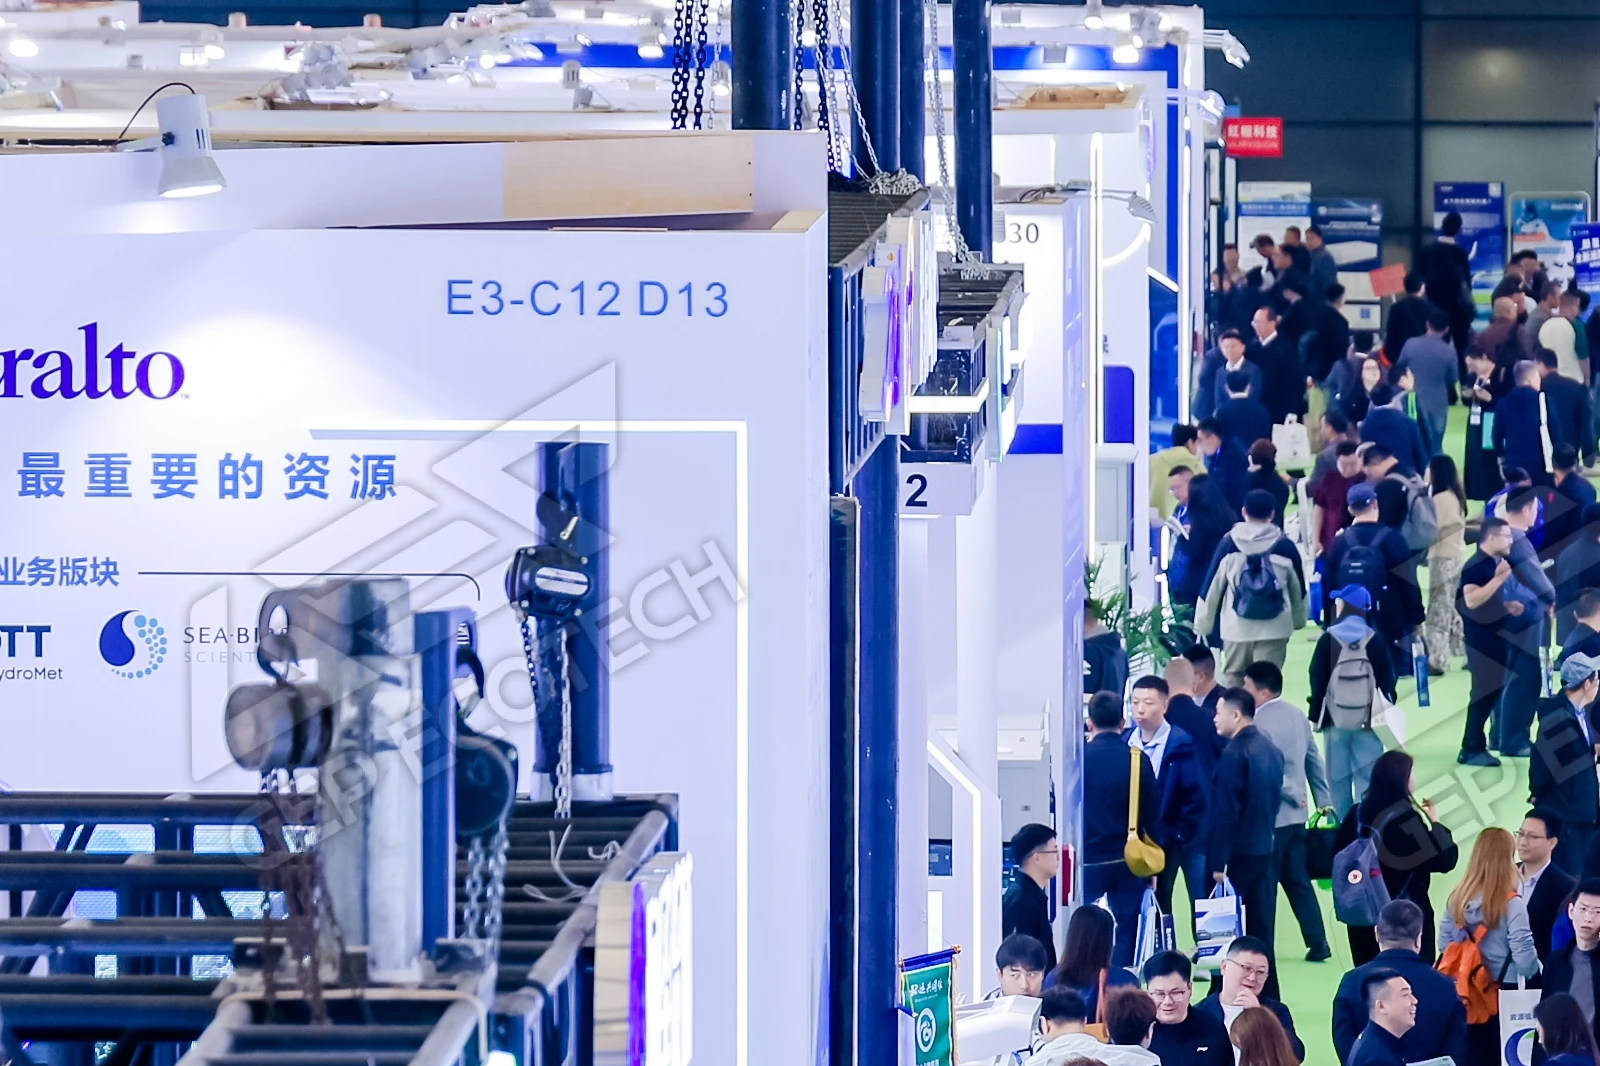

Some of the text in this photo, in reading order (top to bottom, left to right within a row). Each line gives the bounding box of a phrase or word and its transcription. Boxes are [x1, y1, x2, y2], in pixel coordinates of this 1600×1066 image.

[447, 279, 729, 318] E3-C12 D13
[0, 321, 186, 400] ralto
[17, 451, 398, 501] 最重要的资源
[0, 556, 120, 588] 业务版块
[0, 624, 52, 658] TT
